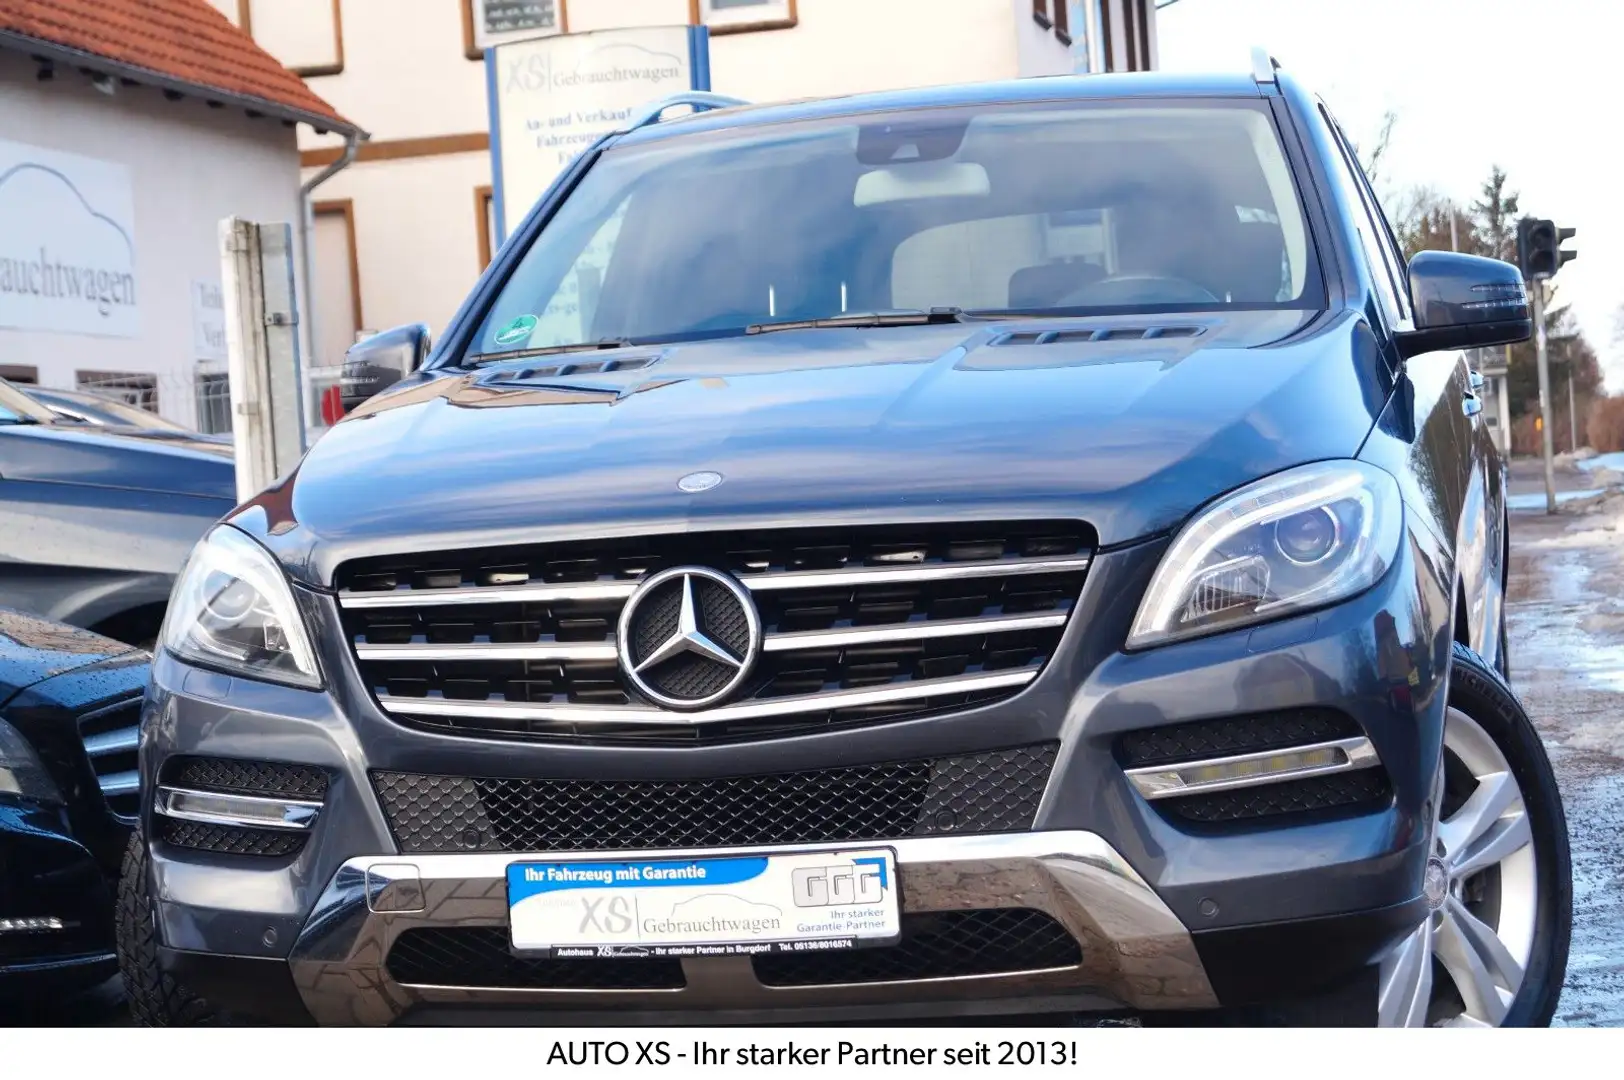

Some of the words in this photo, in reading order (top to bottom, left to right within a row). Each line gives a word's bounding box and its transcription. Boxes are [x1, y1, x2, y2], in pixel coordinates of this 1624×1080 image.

[505, 53, 546, 94] XS
[553, 65, 680, 88] Gebrauchtwagen
[548, 111, 572, 128] und
[576, 106, 633, 123] Verkauf
[525, 868, 545, 882] Ihr
[547, 868, 613, 883] Fahrzeug
[616, 867, 640, 880] mit
[643, 864, 706, 880] Garantie
[791, 865, 884, 907] GGG
[578, 895, 633, 934] XS
[643, 916, 781, 936] Gebrauchtwagen
[831, 910, 845, 919] Ihr
[848, 908, 885, 918] starker
[557, 948, 594, 957] Autohaus
[596, 945, 613, 957] XS
[656, 947, 666, 955] Ihr
[668, 946, 695, 955] starker
[696, 945, 725, 954] Partner
[726, 944, 735, 953] in
[736, 943, 772, 954] Burgdorf
[778, 942, 794, 951] Tel.
